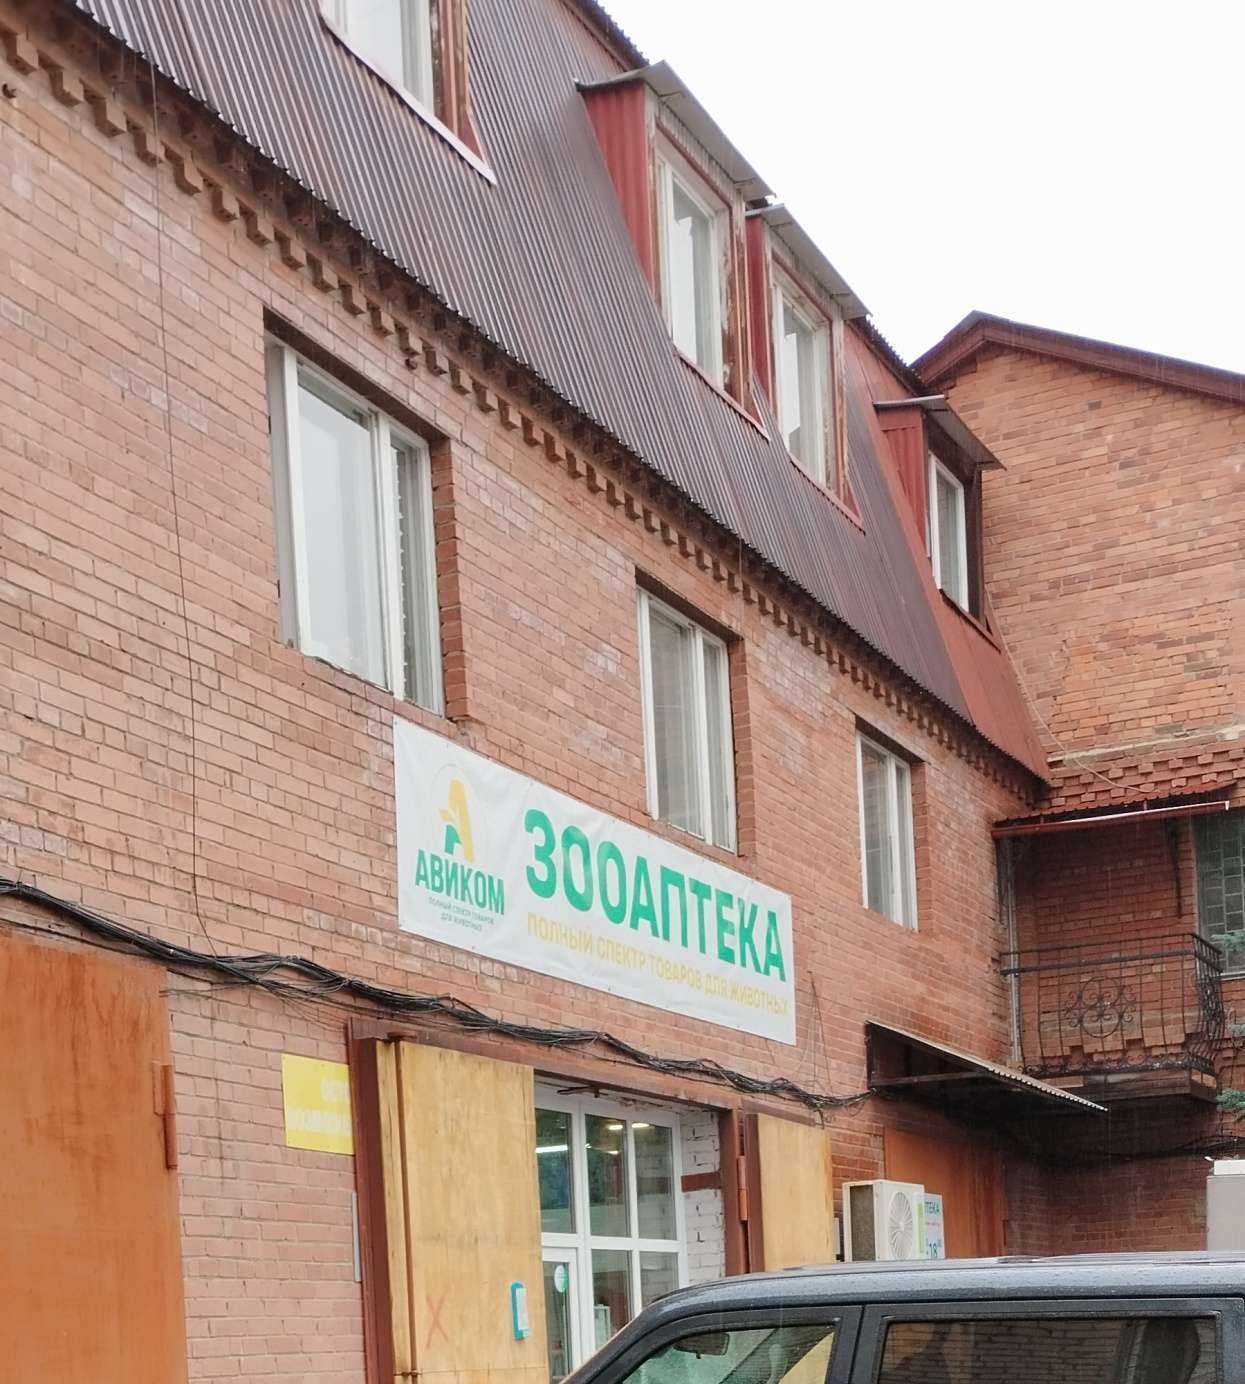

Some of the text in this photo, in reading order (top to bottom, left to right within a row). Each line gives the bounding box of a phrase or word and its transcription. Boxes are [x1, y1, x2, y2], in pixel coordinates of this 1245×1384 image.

[415, 848, 505, 916] АВИКОМ
[524, 808, 787, 982] ЗООАПТЕКА
[527, 911, 789, 1015] ПОЛНЫЙ СПЕКТР ТОВАРОВ ДЛЯ ЖИВОТНЫХ
